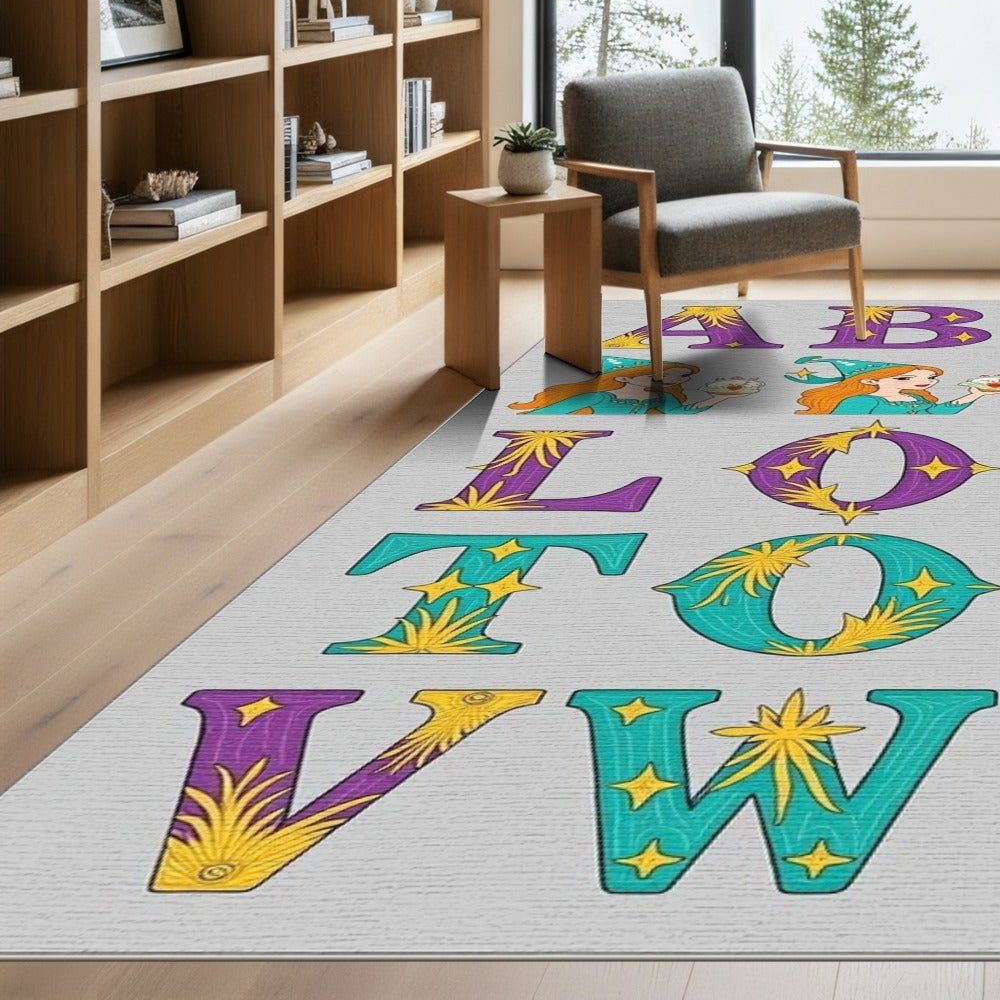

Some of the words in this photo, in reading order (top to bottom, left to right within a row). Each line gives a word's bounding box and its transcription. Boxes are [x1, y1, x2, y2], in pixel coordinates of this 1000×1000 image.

[602, 305, 784, 349] A
[809, 305, 992, 349] B
[415, 430, 662, 512] L
[322, 532, 647, 655] T
[148, 689, 547, 893] V
[566, 688, 998, 894] W
